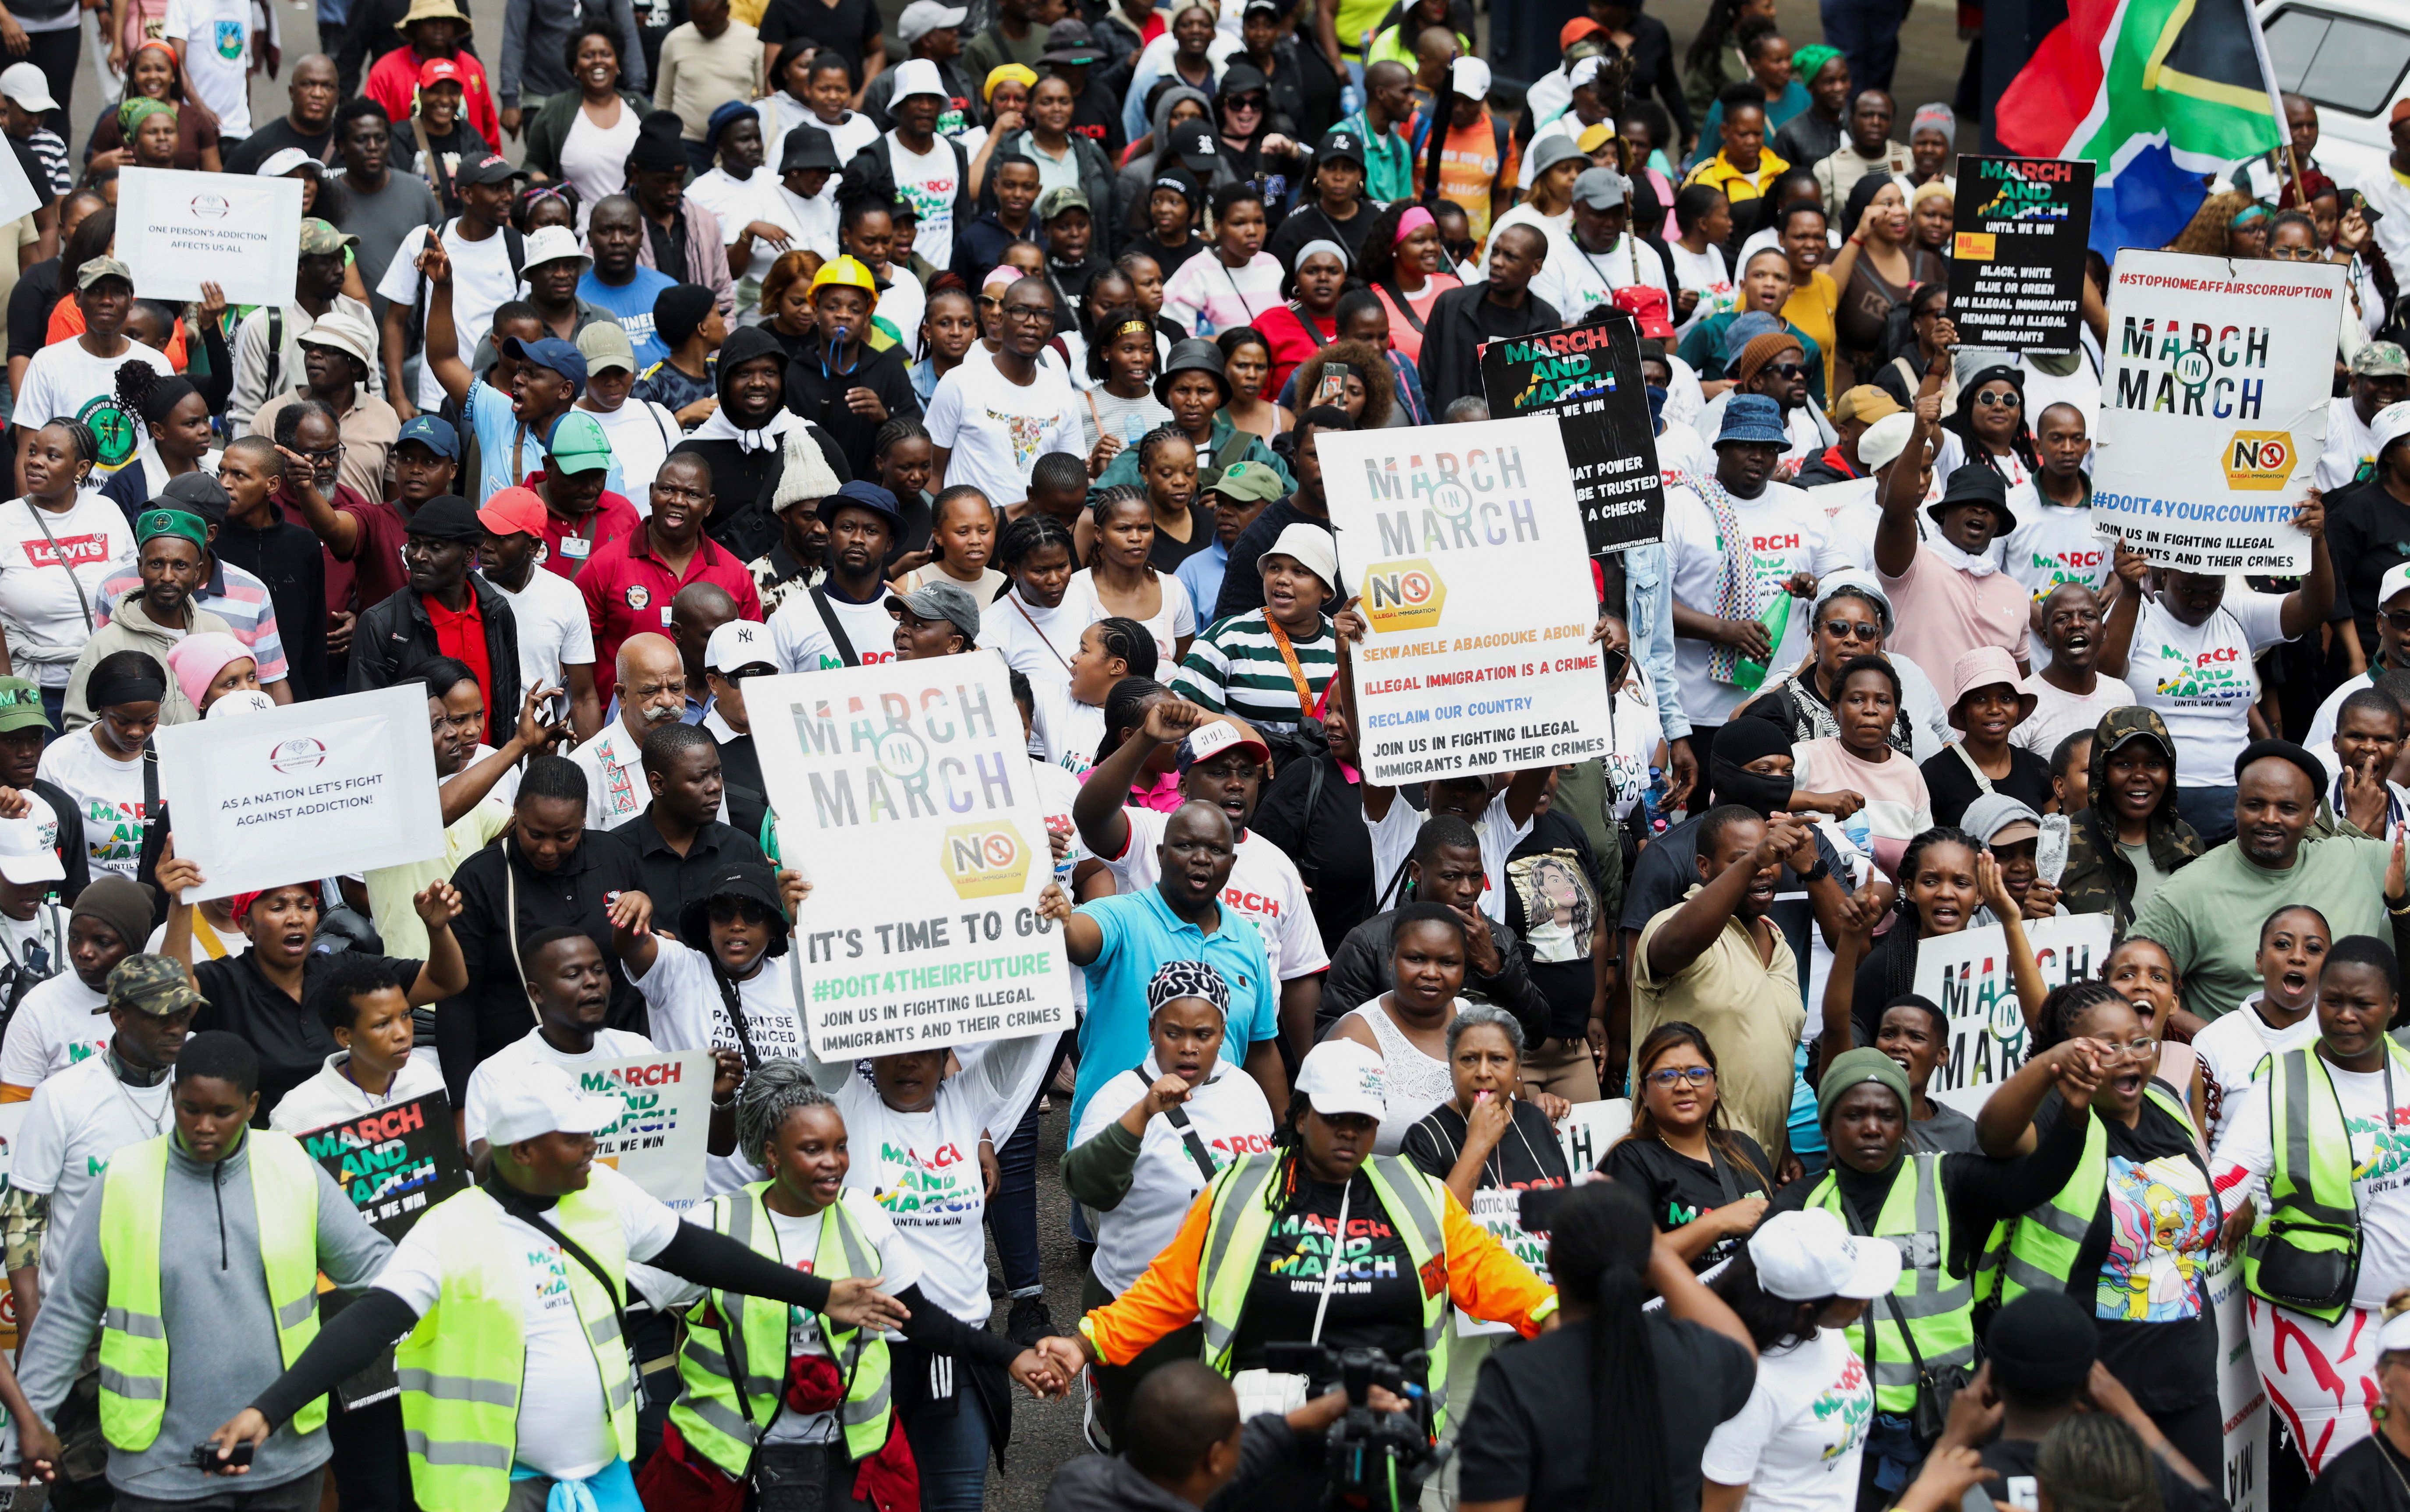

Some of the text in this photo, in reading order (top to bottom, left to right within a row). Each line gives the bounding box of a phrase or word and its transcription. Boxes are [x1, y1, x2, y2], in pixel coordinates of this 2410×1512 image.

[1980, 160, 2072, 182] MARCH
[1996, 181, 2052, 200] AND
[1977, 199, 2069, 221] MARCH
[149, 225, 267, 241] ONE PERSON'S ADDICTION
[1985, 221, 2055, 235] UNTIL WE WIN
[171, 241, 243, 253] AFFECTS US ALL
[1980, 265, 2052, 279] BLACK, WHITE
[1974, 281, 2055, 295] BLUE OR GREEN
[1953, 296, 2077, 312] AN ILLEGAL IMMIGRANTS
[1960, 312, 2067, 328] REMAINS AN ILLEGAL
[1504, 326, 1609, 365] MARCH
[1981, 328, 2044, 343] IMMIGRANTS
[2122, 316, 2270, 368] MARCH
[1530, 353, 1592, 384] AND
[2184, 359, 2201, 376] IN
[1514, 371, 1617, 409] MARCH
[2116, 367, 2264, 419] MARCH
[1563, 398, 1605, 418] WE WIN
[1597, 456, 1643, 476] POWER
[2233, 439, 2286, 470] NO
[1364, 446, 1527, 502] MARCH
[1441, 490, 1460, 508] IN
[1577, 474, 1659, 502] BE TRUSTED
[1588, 499, 1647, 522] A CHECK
[1376, 498, 1540, 556] MARCH
[2095, 521, 2274, 549] JOIN US IN FIGHTING ILLEGAL
[2032, 551, 2105, 569] MARCH
[2175, 552, 2293, 567] AND THEIR CRIMES
[1371, 571, 1432, 609] NO
[1398, 607, 1436, 616] IMMIGRATION
[1363, 623, 1586, 662] SEKWANELE ABAGODUKE ABONI
[1364, 655, 1598, 696] ILLEGAL IMMIGRATION IS A CRIME
[2178, 663, 2233, 681] AND
[2157, 678, 2251, 698] MARCH
[790, 683, 997, 758] MARCH
[1368, 696, 1533, 729] RECLAIM OUR COUNTRY
[1372, 720, 1580, 758] JOIN US IN FIGHTING ILLEGAL
[284, 759, 315, 767] Foundation
[888, 742, 914, 765] IN
[1375, 737, 1604, 779] IMMIGRANTS AND THEIR CRIMES
[221, 773, 383, 810] AS A NATION LET'S FIGHT
[808, 751, 1015, 829] MARCH
[237, 795, 373, 828] AGAINST ADDICTION!
[950, 833, 1016, 872] NO
[107, 862, 134, 871] UNTIL
[808, 907, 1053, 963] IT'S TIME TO GO
[812, 951, 1051, 1002] #DOIT4THEIRFUTURE
[820, 987, 1035, 1027] JOIN US IN FIGHTING ILLEGAL
[2000, 1003, 2016, 1027] IN
[822, 1007, 1061, 1051] IMMIGRANTS AND THEIR CRIMES
[788, 1046, 798, 1058] IN
[580, 1061, 683, 1092] MARCH
[305, 1103, 425, 1161] MARCH
[619, 1135, 664, 1153] WE WIN
[340, 1138, 408, 1185] AND
[897, 1167, 957, 1192] AND
[379, 1190, 427, 1219] WE WIN
[873, 1184, 980, 1214] MARCH
[893, 1216, 962, 1227] UNTIL WE WIN
[1271, 1213, 1392, 1238] MARCH
[1296, 1235, 1372, 1258] AND
[1271, 1254, 1397, 1279] MARCH
[1290, 1280, 1325, 1294] UNTIL
[1348, 1281, 1371, 1294] WIN
